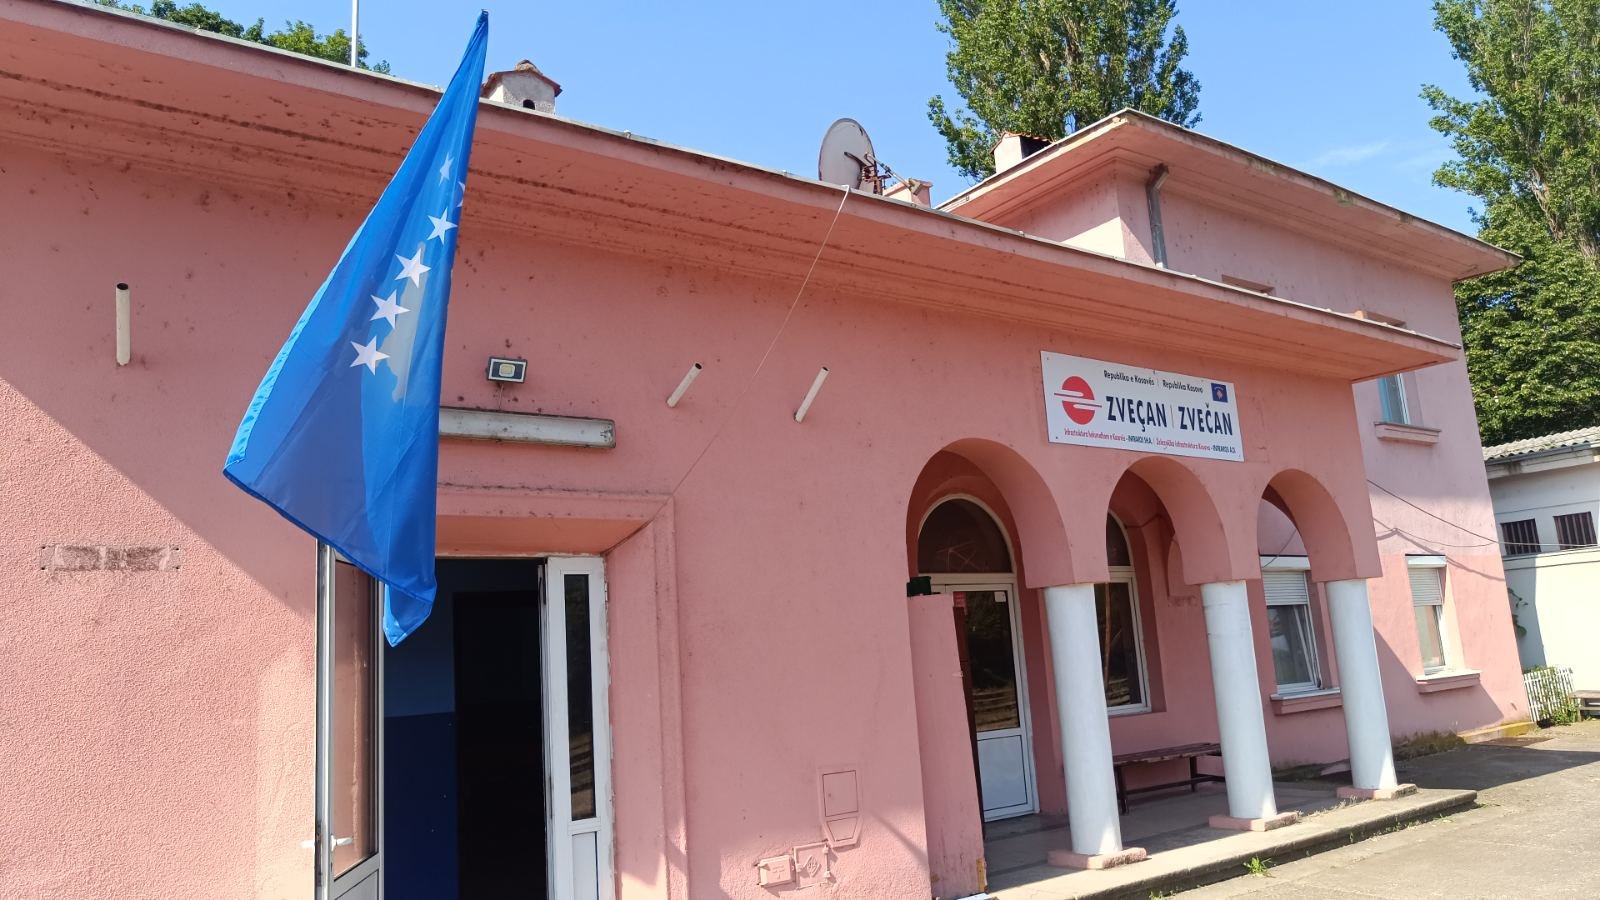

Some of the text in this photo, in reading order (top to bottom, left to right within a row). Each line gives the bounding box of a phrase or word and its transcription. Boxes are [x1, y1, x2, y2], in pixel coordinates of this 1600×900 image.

[1103, 369, 1130, 381] Republika
[1162, 379, 1187, 391] Republika
[1105, 395, 1168, 433] ZVEÇAN
[1178, 402, 1233, 436] ZVEČAN
